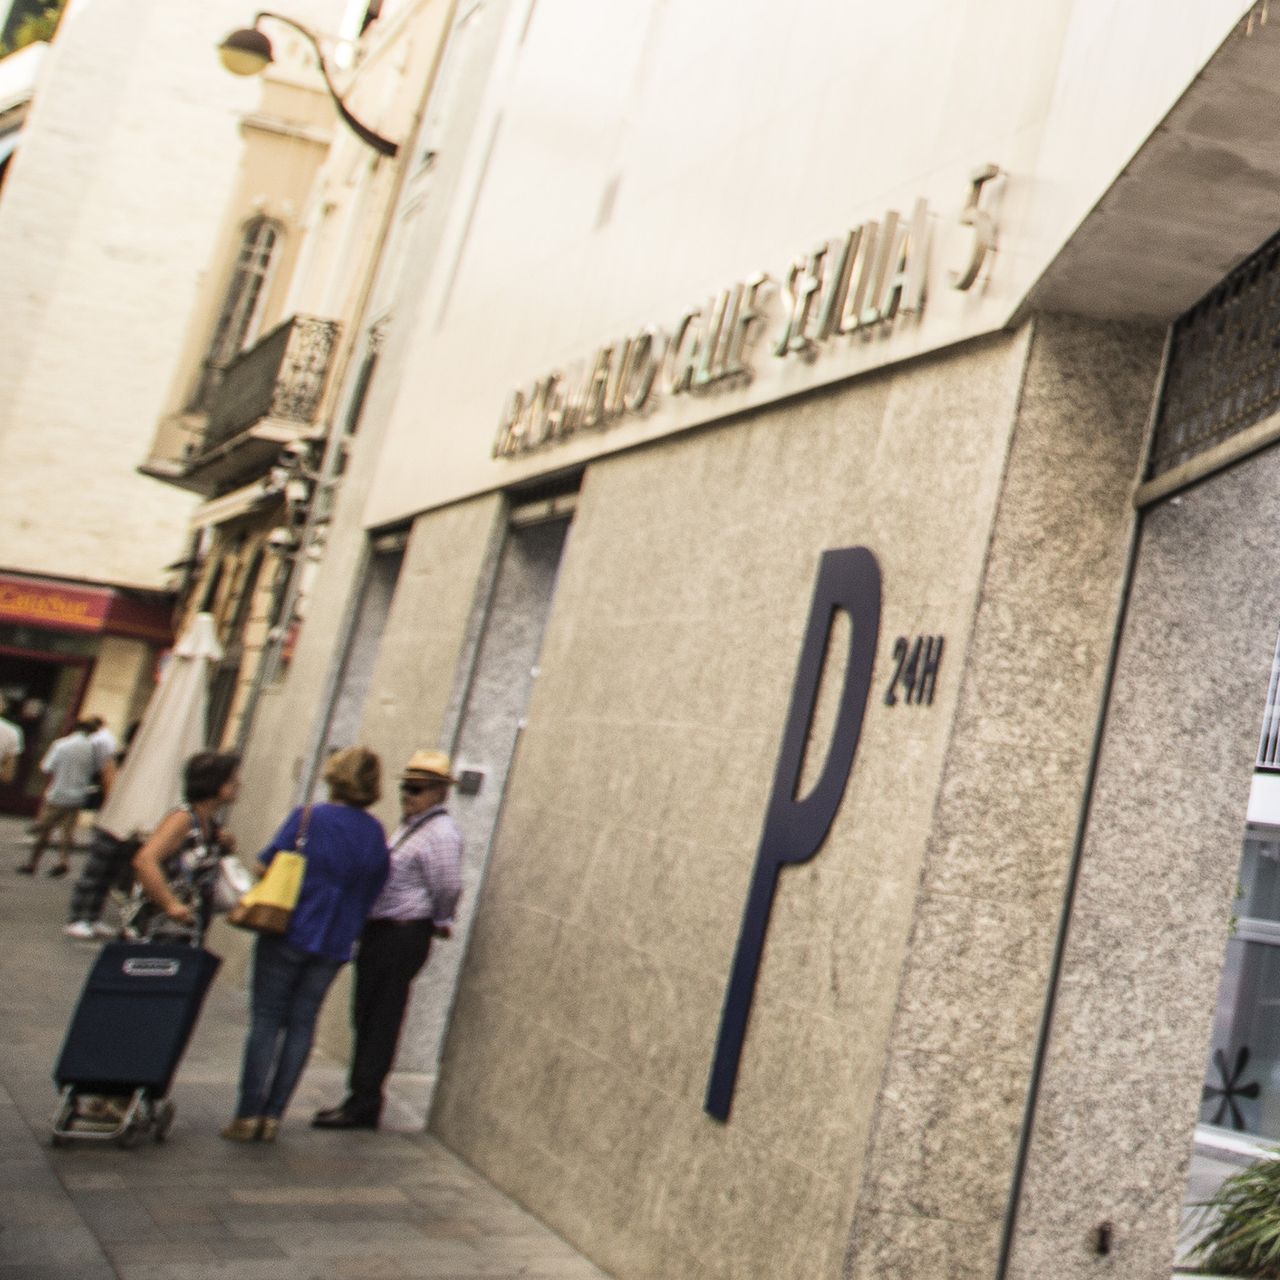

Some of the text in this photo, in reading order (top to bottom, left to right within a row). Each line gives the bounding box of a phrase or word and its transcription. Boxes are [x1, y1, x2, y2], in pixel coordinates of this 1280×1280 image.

[952, 163, 1001, 292] 5
[703, 545, 945, 1125] P 24H
